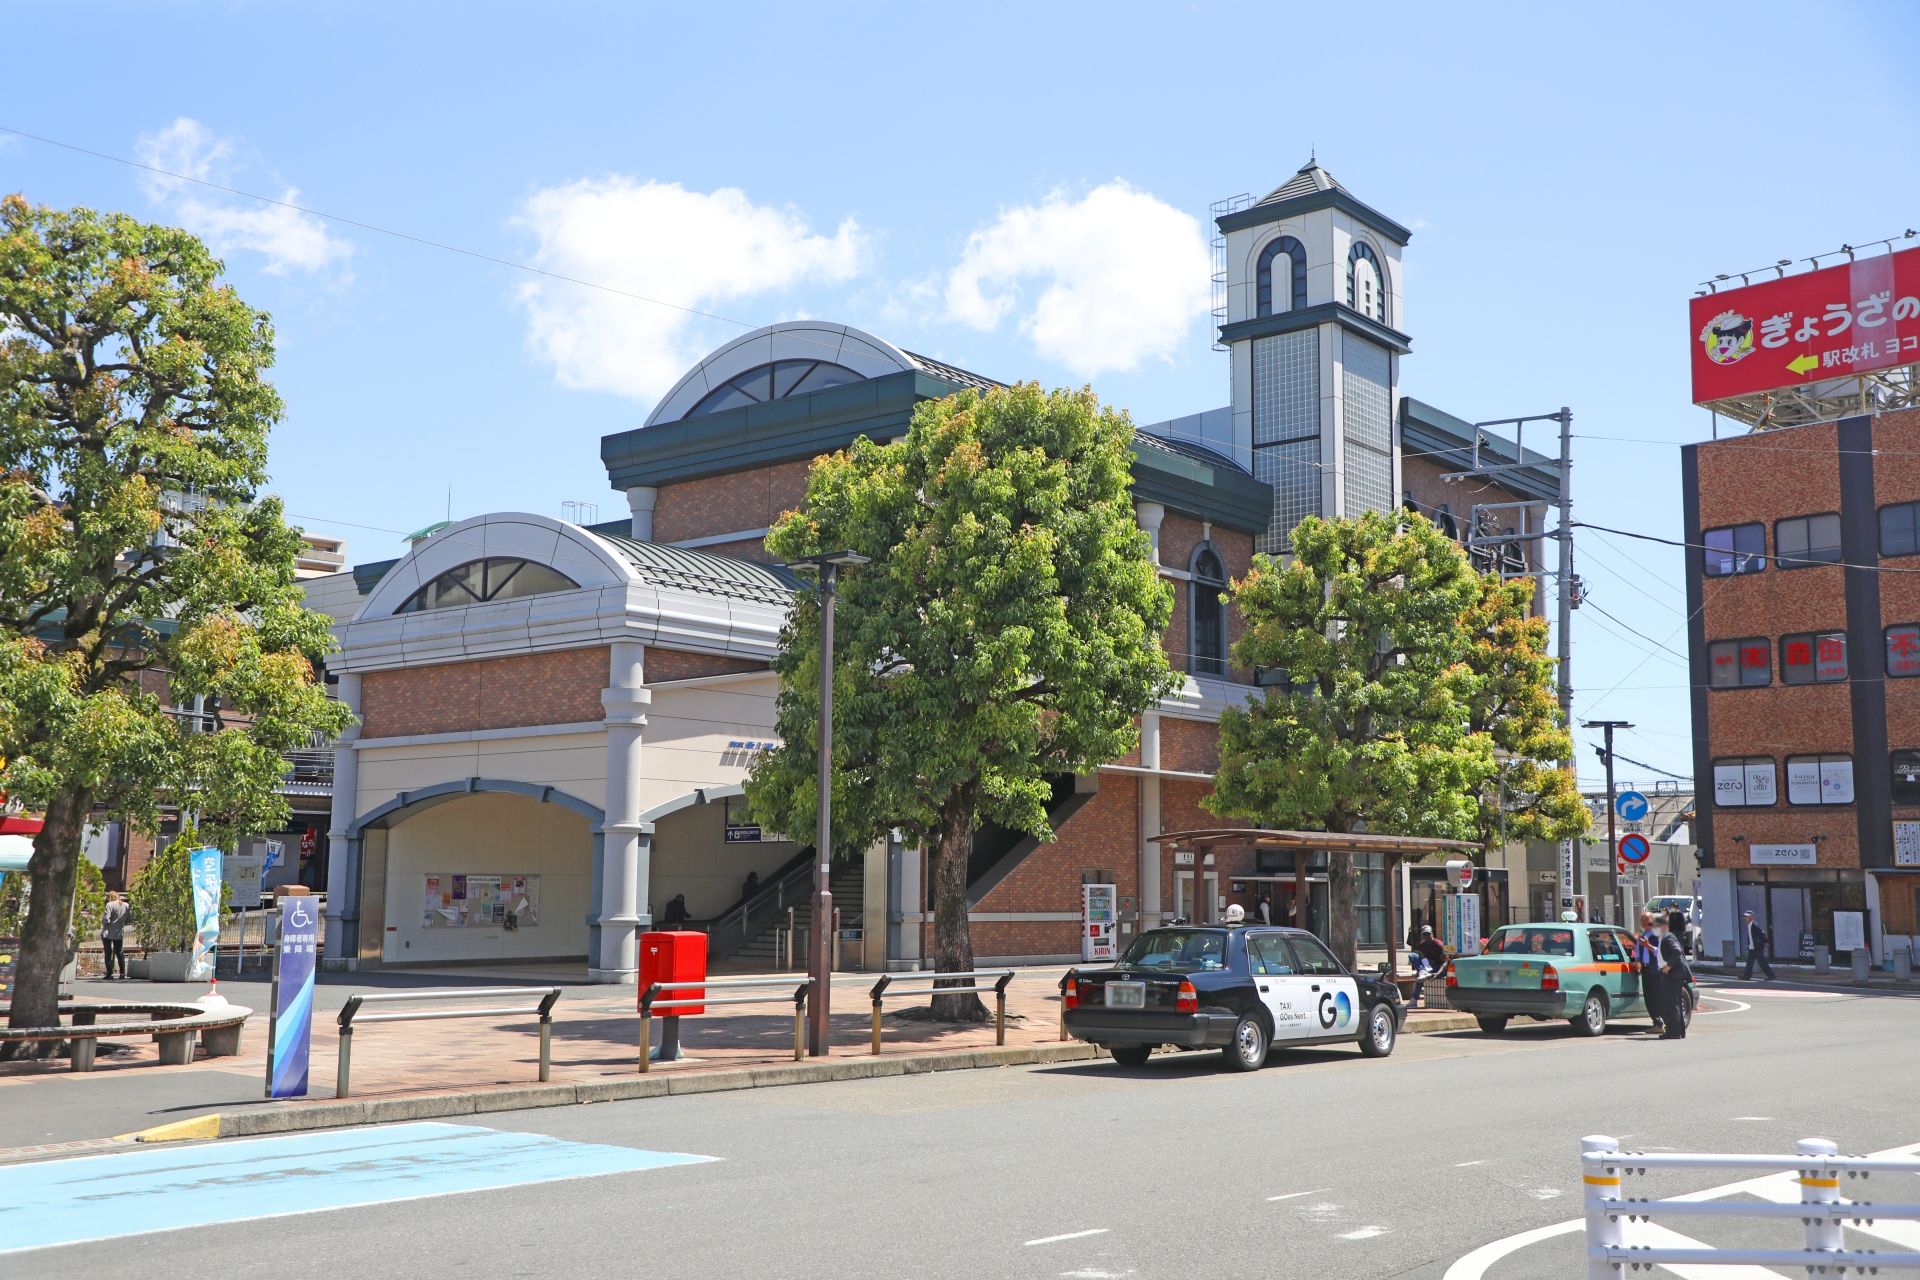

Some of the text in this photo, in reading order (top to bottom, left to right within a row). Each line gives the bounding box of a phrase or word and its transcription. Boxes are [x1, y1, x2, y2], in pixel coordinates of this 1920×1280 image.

[1759, 290, 1920, 349] ぎょうざの
[1822, 341, 1880, 368] 駅改札
[1717, 781, 1743, 790] zero
[1774, 849, 1799, 857] zero
[283, 934, 315, 943] 身障者専用
[1094, 947, 1111, 956] KIRIN
[1280, 1002, 1292, 1010] TAXI
